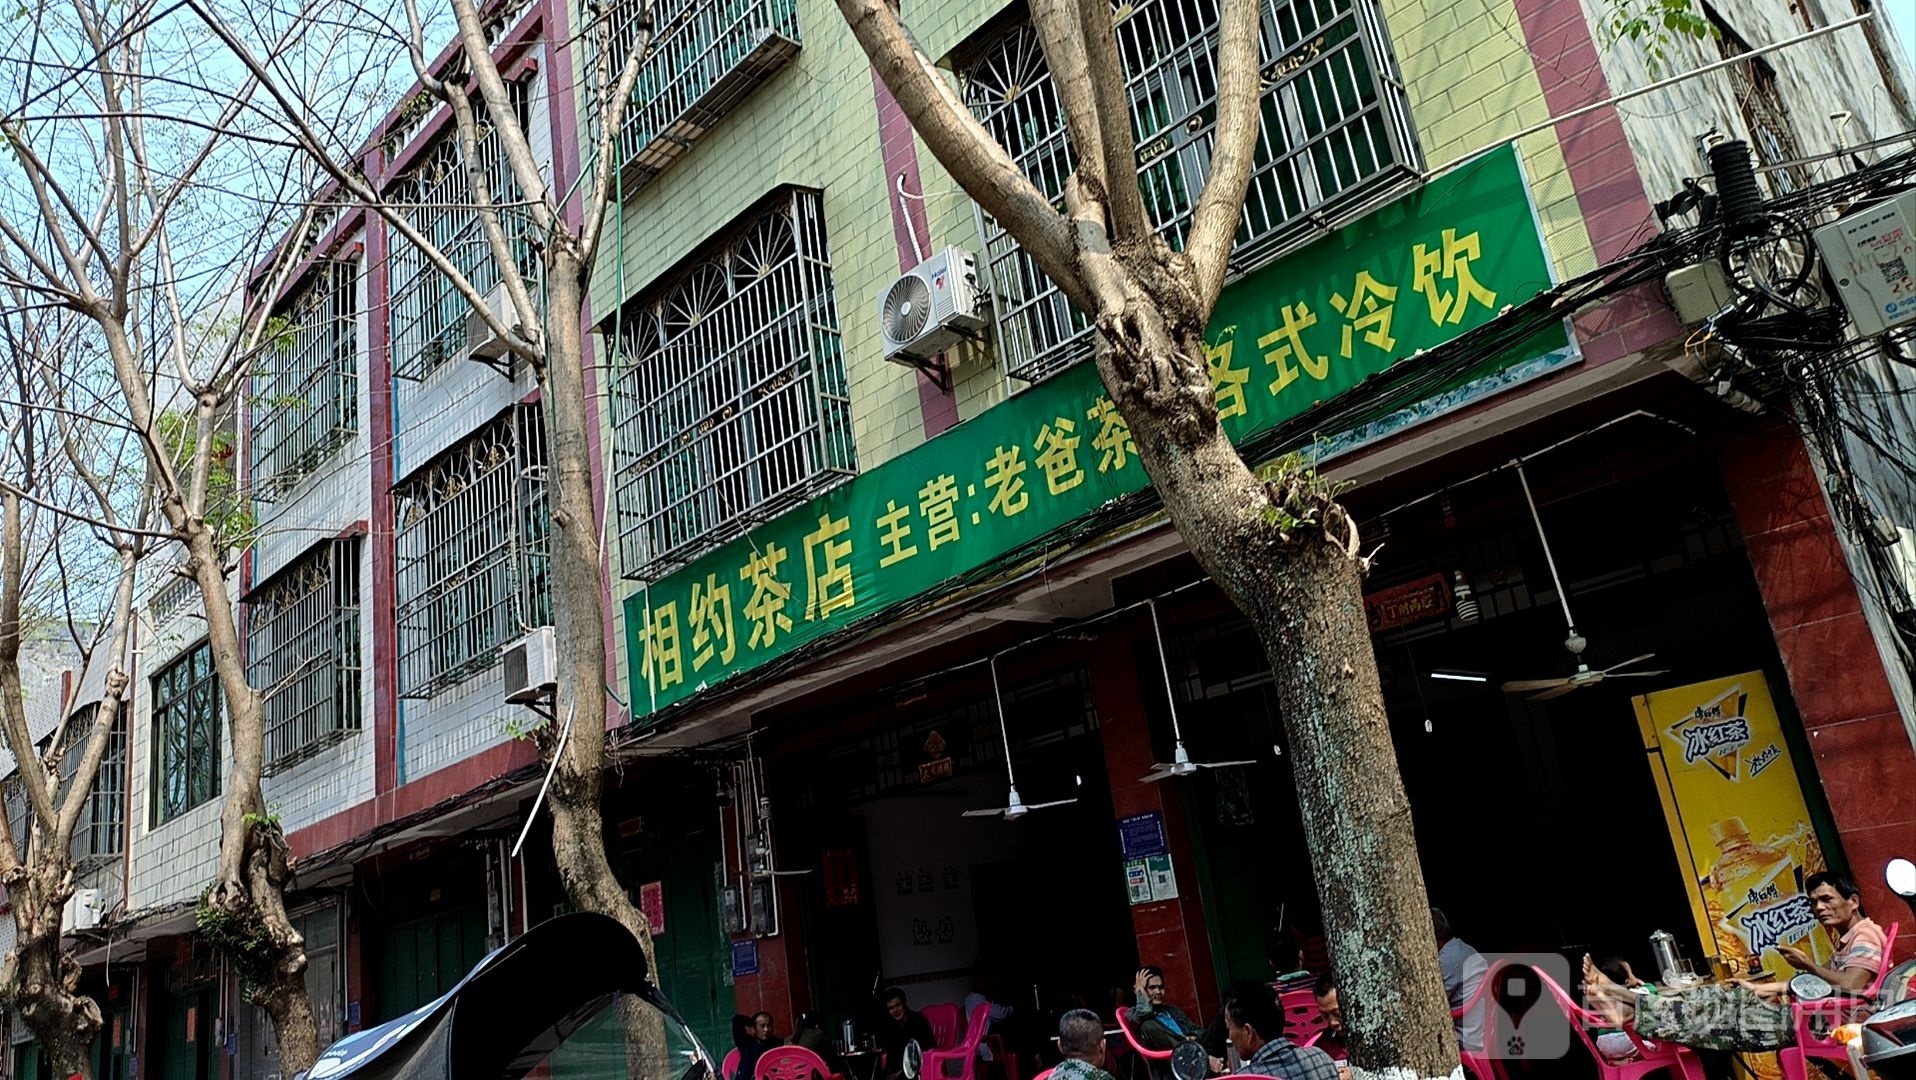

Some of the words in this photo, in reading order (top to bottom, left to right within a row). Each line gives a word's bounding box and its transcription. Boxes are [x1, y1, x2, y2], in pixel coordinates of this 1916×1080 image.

[638, 513, 856, 692] 相约茶店
[1203, 227, 1498, 421] 各式冷饮
[1683, 718, 1749, 763] 冰红茶
[1740, 894, 1816, 955] 冰红茶
